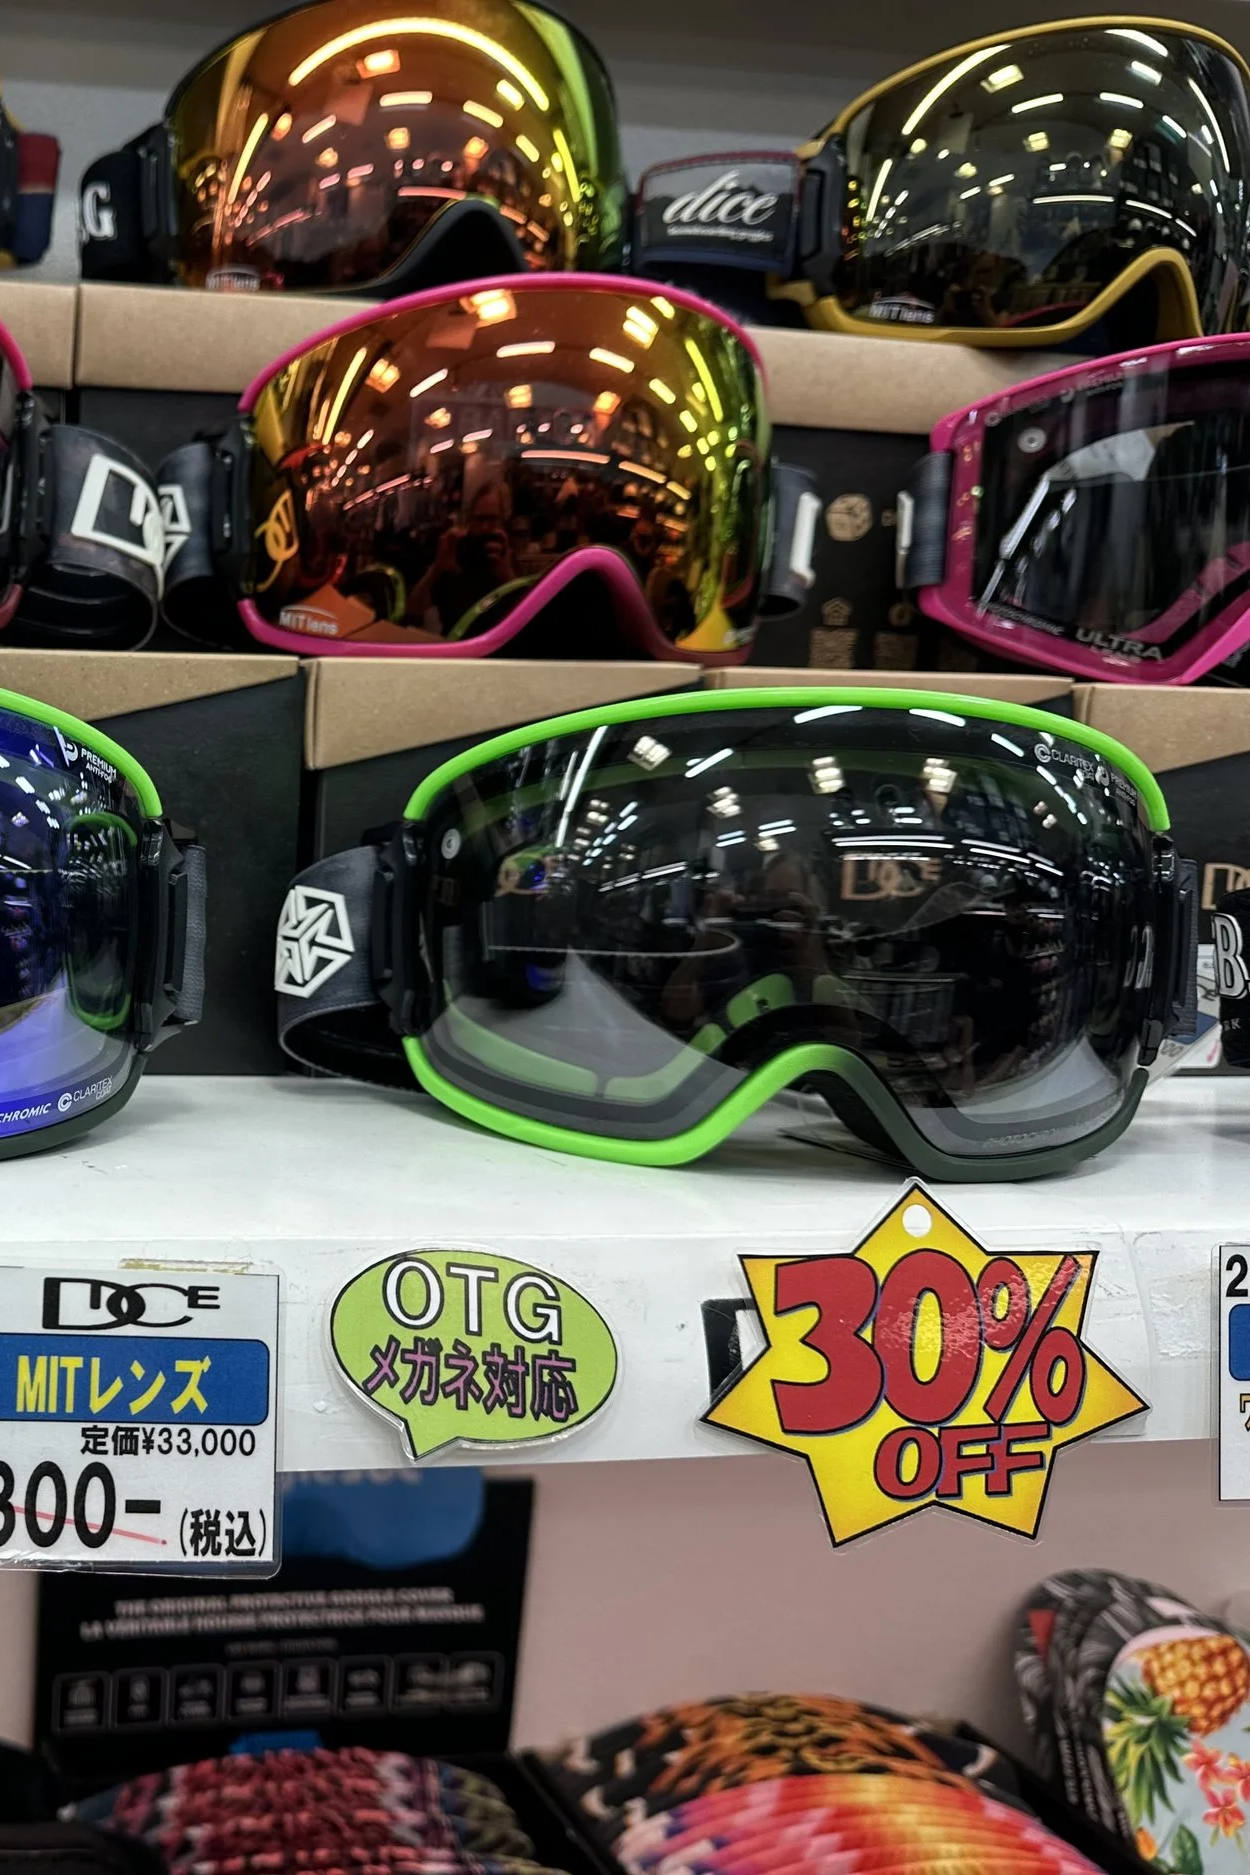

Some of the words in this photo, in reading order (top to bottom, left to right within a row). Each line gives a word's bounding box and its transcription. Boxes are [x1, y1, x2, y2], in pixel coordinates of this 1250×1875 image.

[662, 169, 778, 225] dice
[307, 616, 339, 636] lens
[1075, 626, 1165, 662] ULTRA
[81, 747, 117, 780] PREMIUM
[1051, 749, 1095, 773] CLARITEX
[73, 1075, 113, 1103] CLARITEX
[42, 1276, 221, 1331] DICE
[382, 1256, 563, 1345] OTG
[771, 1248, 1086, 1434] 30%
[362, 1335, 579, 1422] メガネ対応
[873, 1420, 1051, 1501] OFF
[179, 1508, 267, 1557] (税込)
